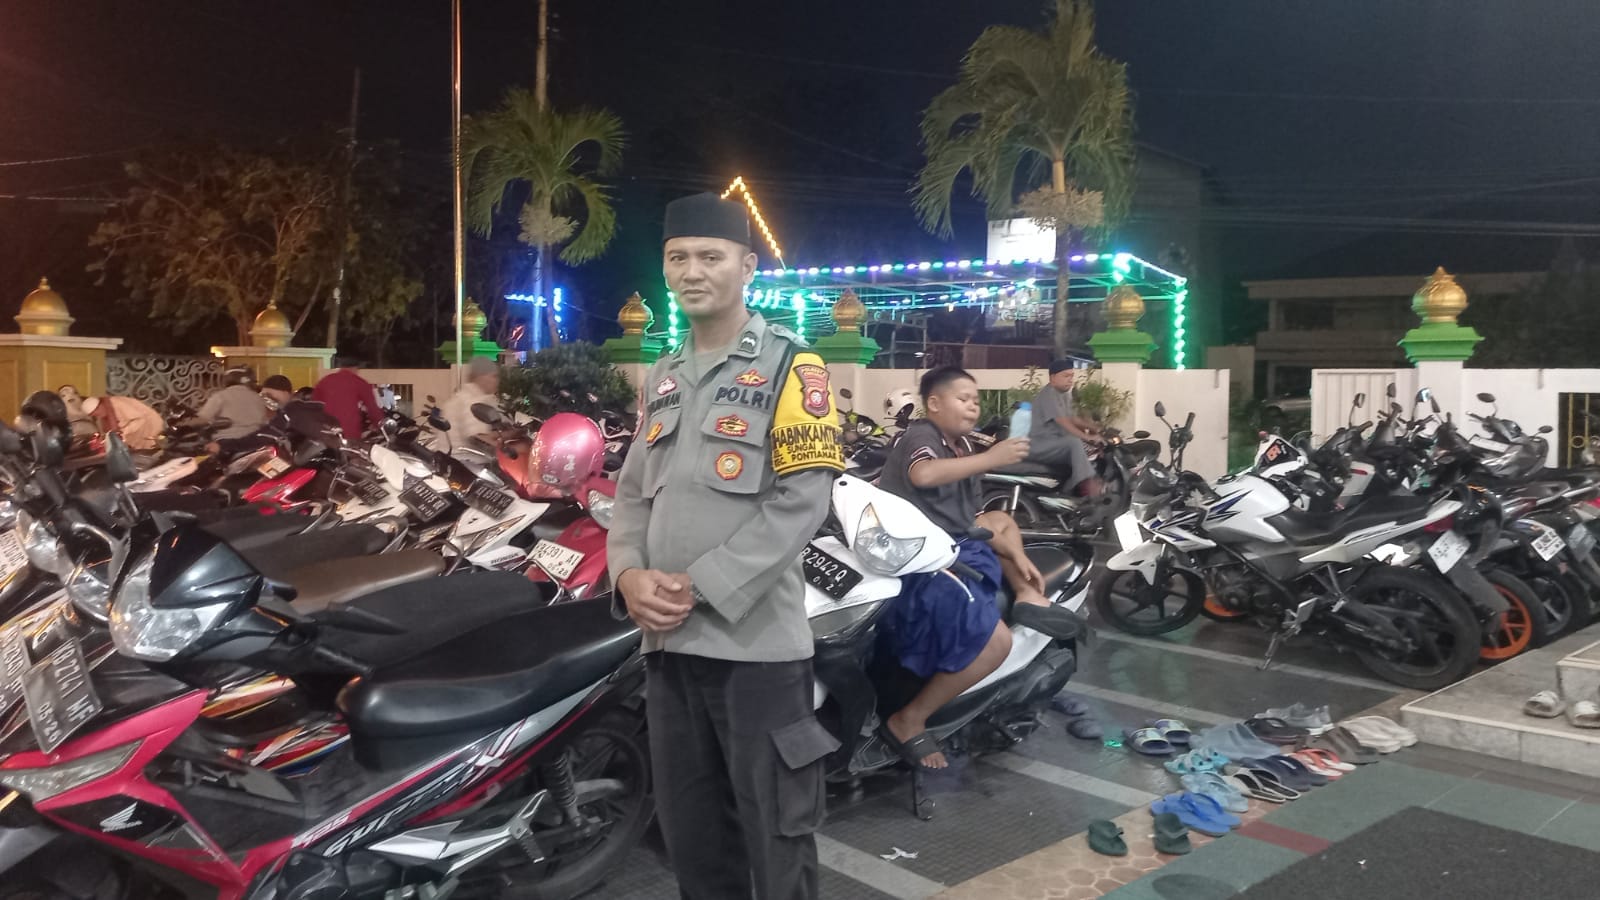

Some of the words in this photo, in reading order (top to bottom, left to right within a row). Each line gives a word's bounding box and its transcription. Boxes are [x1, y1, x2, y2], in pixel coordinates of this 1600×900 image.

[715, 386, 772, 409] POLRI
[787, 442, 816, 455] SUNGAI
[806, 552, 838, 576] 2942
[835, 569, 847, 582] Q
[51, 641, 77, 666] KB
[55, 659, 84, 699] 2741
[65, 694, 95, 722] MF
